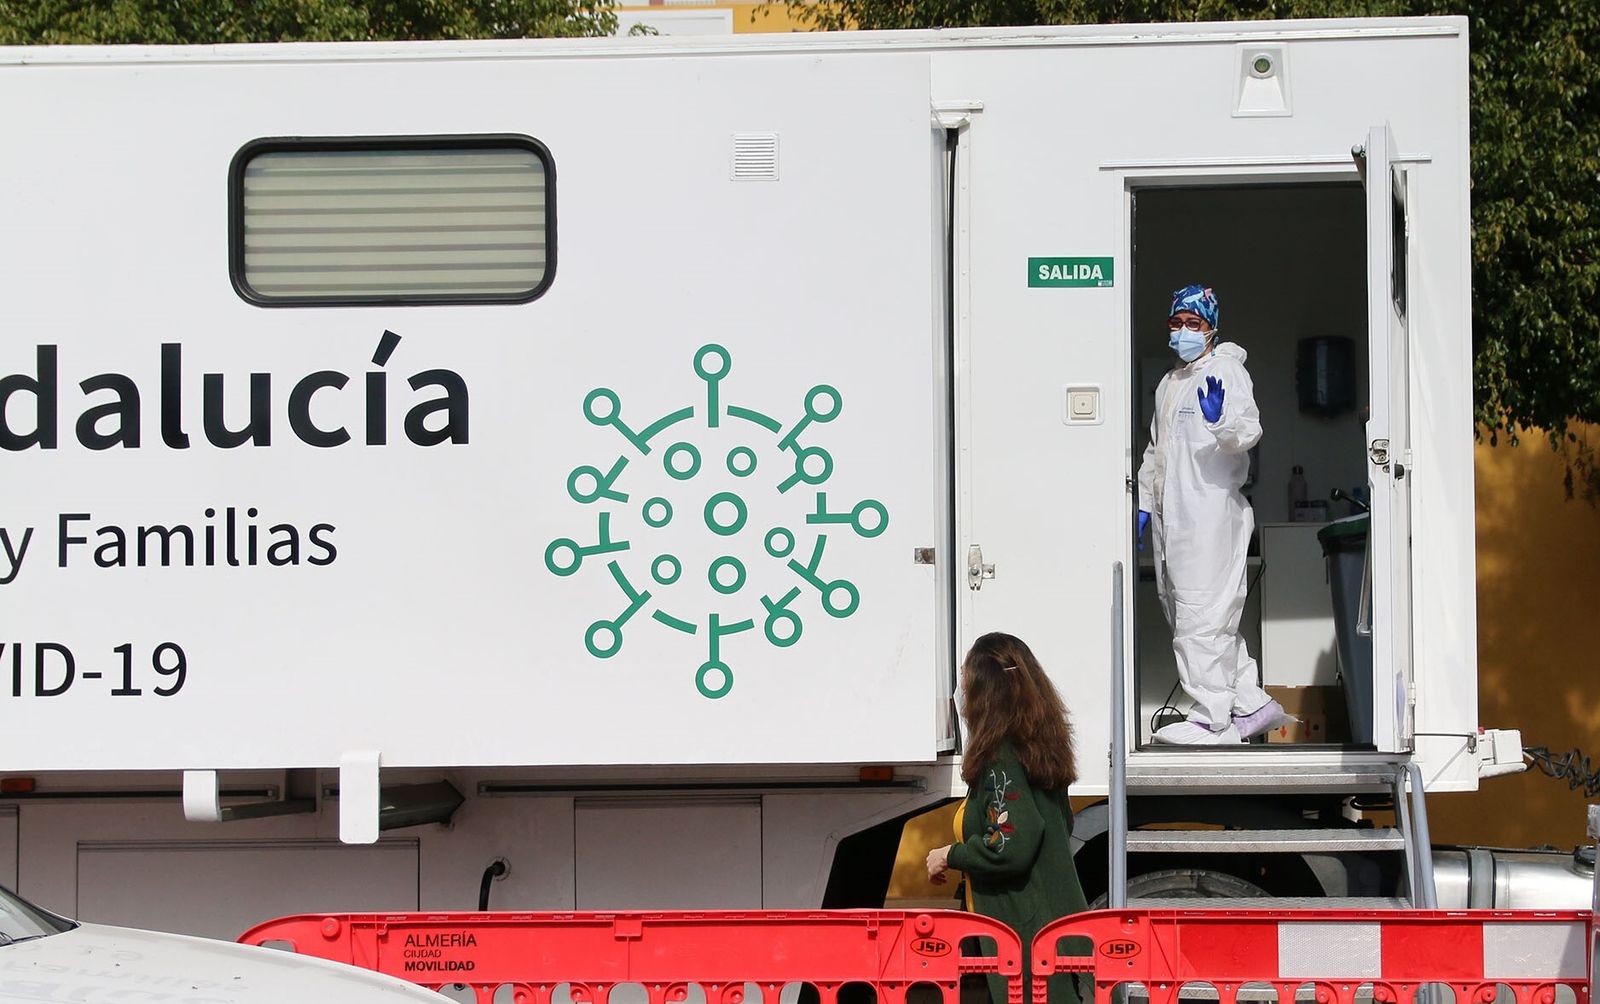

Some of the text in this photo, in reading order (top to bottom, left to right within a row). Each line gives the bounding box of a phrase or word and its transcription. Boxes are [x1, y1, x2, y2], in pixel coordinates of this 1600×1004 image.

[1038, 264, 1104, 280] SALIDA
[0, 330, 469, 451] dalucía
[0, 507, 337, 584] y Familias
[0, 642, 186, 696] ID-19
[404, 931, 477, 947] ALMERÍA
[917, 941, 946, 953] JSP
[403, 949, 442, 958] CIUDAD
[1106, 943, 1136, 955] JSP
[404, 961, 475, 971] MOVILIDAD
